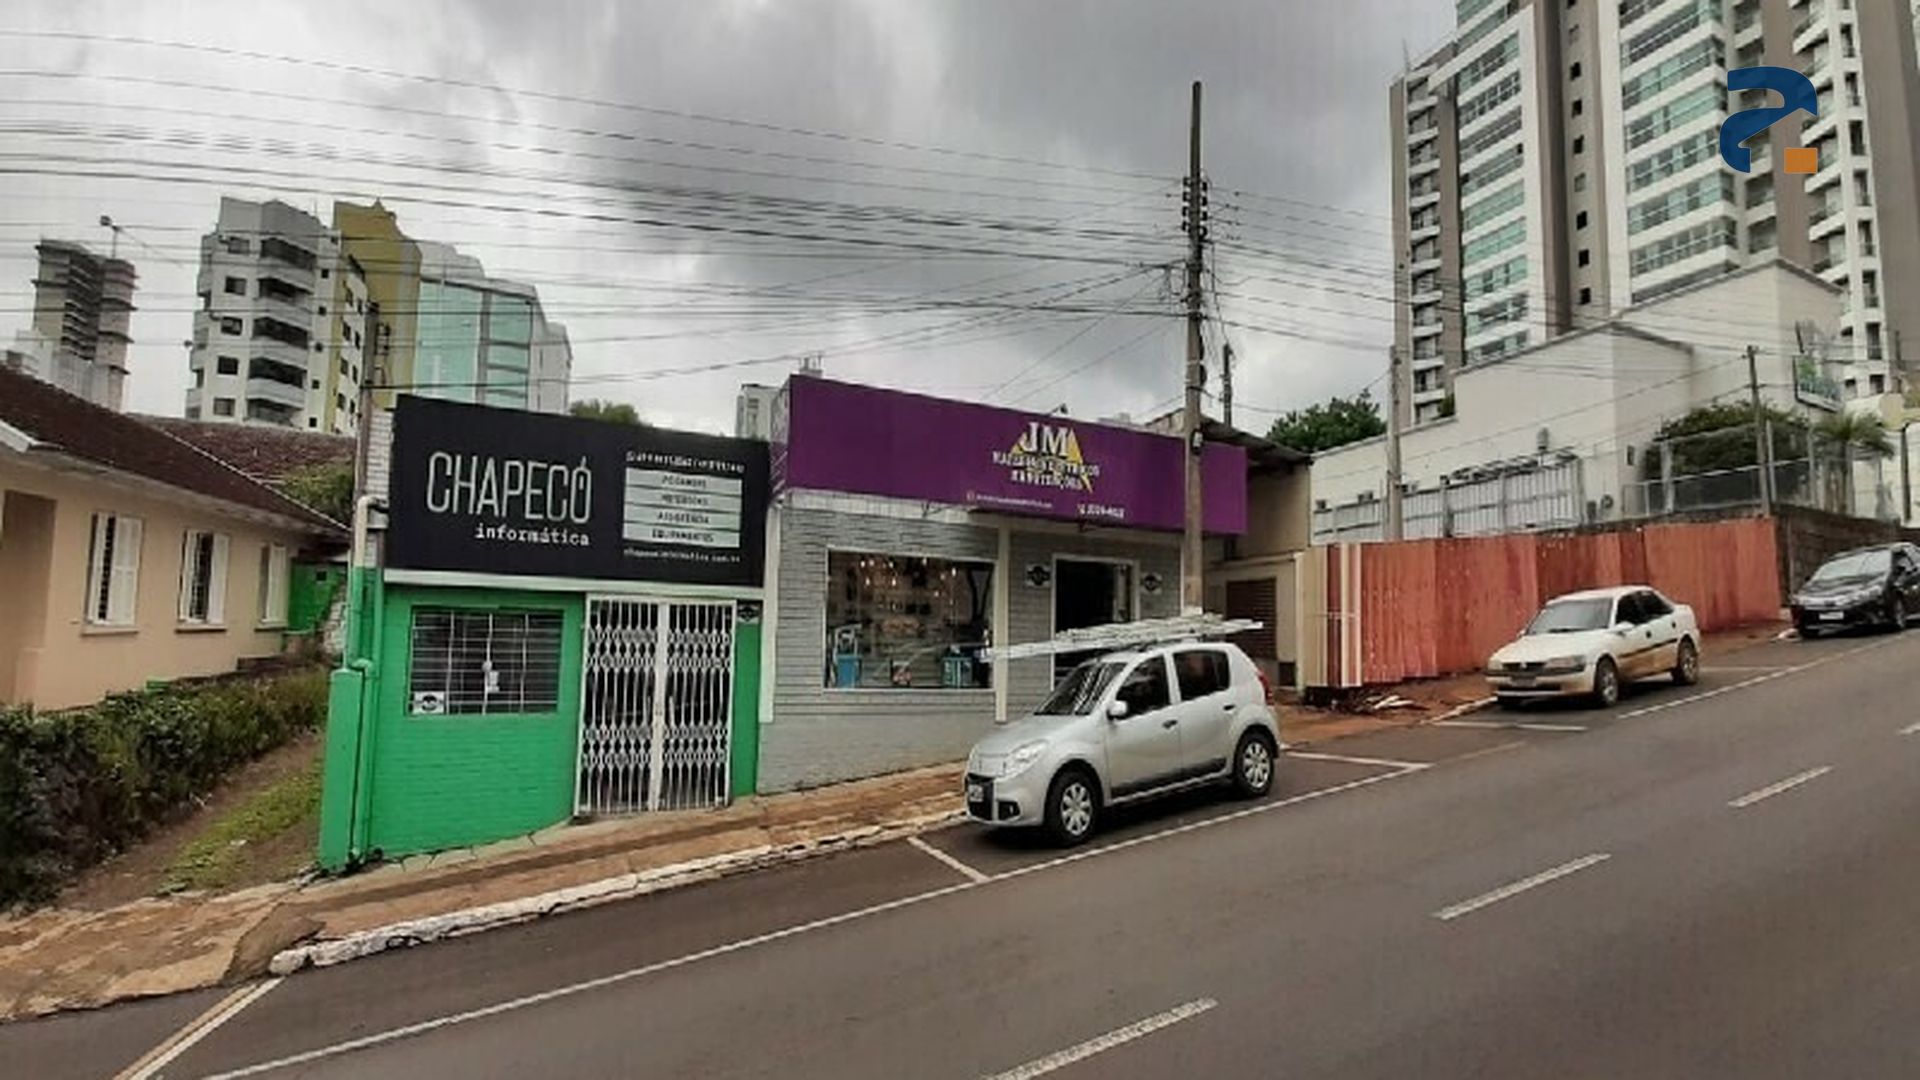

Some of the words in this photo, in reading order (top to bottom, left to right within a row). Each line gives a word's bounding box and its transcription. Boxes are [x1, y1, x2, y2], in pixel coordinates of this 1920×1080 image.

[1019, 422, 1069, 456] JM
[427, 452, 592, 524] CHAPECÓ
[475, 523, 589, 546] informática
